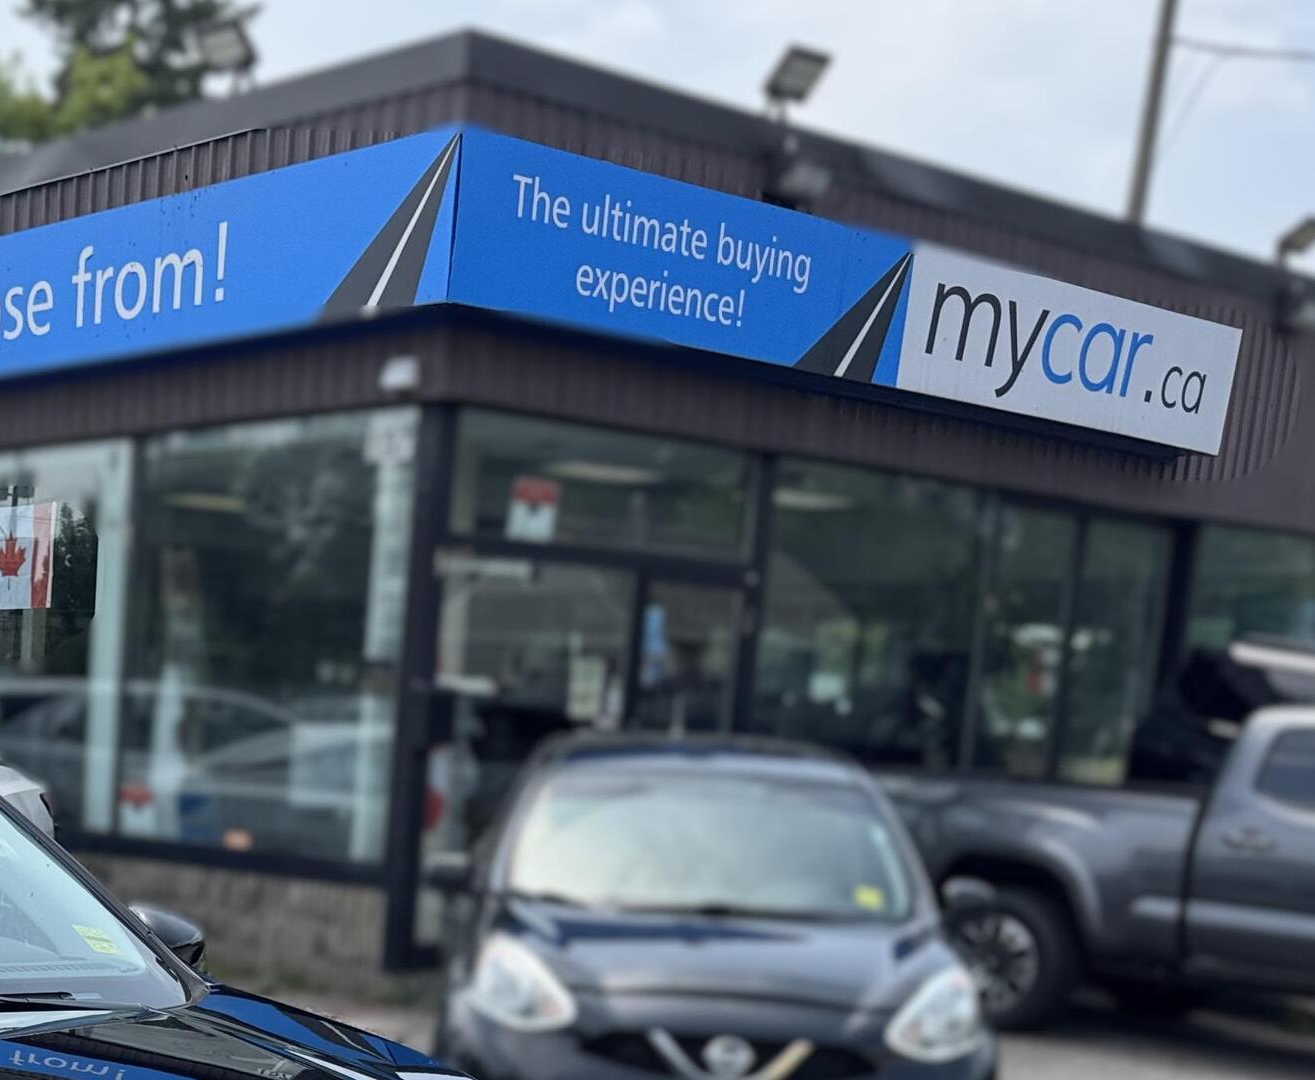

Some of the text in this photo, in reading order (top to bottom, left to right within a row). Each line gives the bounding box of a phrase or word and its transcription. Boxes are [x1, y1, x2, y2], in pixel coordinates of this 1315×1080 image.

[71, 221, 229, 328] from!
[512, 173, 812, 294] The ultimate buying
[576, 263, 746, 328] experience!
[924, 282, 1207, 415] mycar.ca
